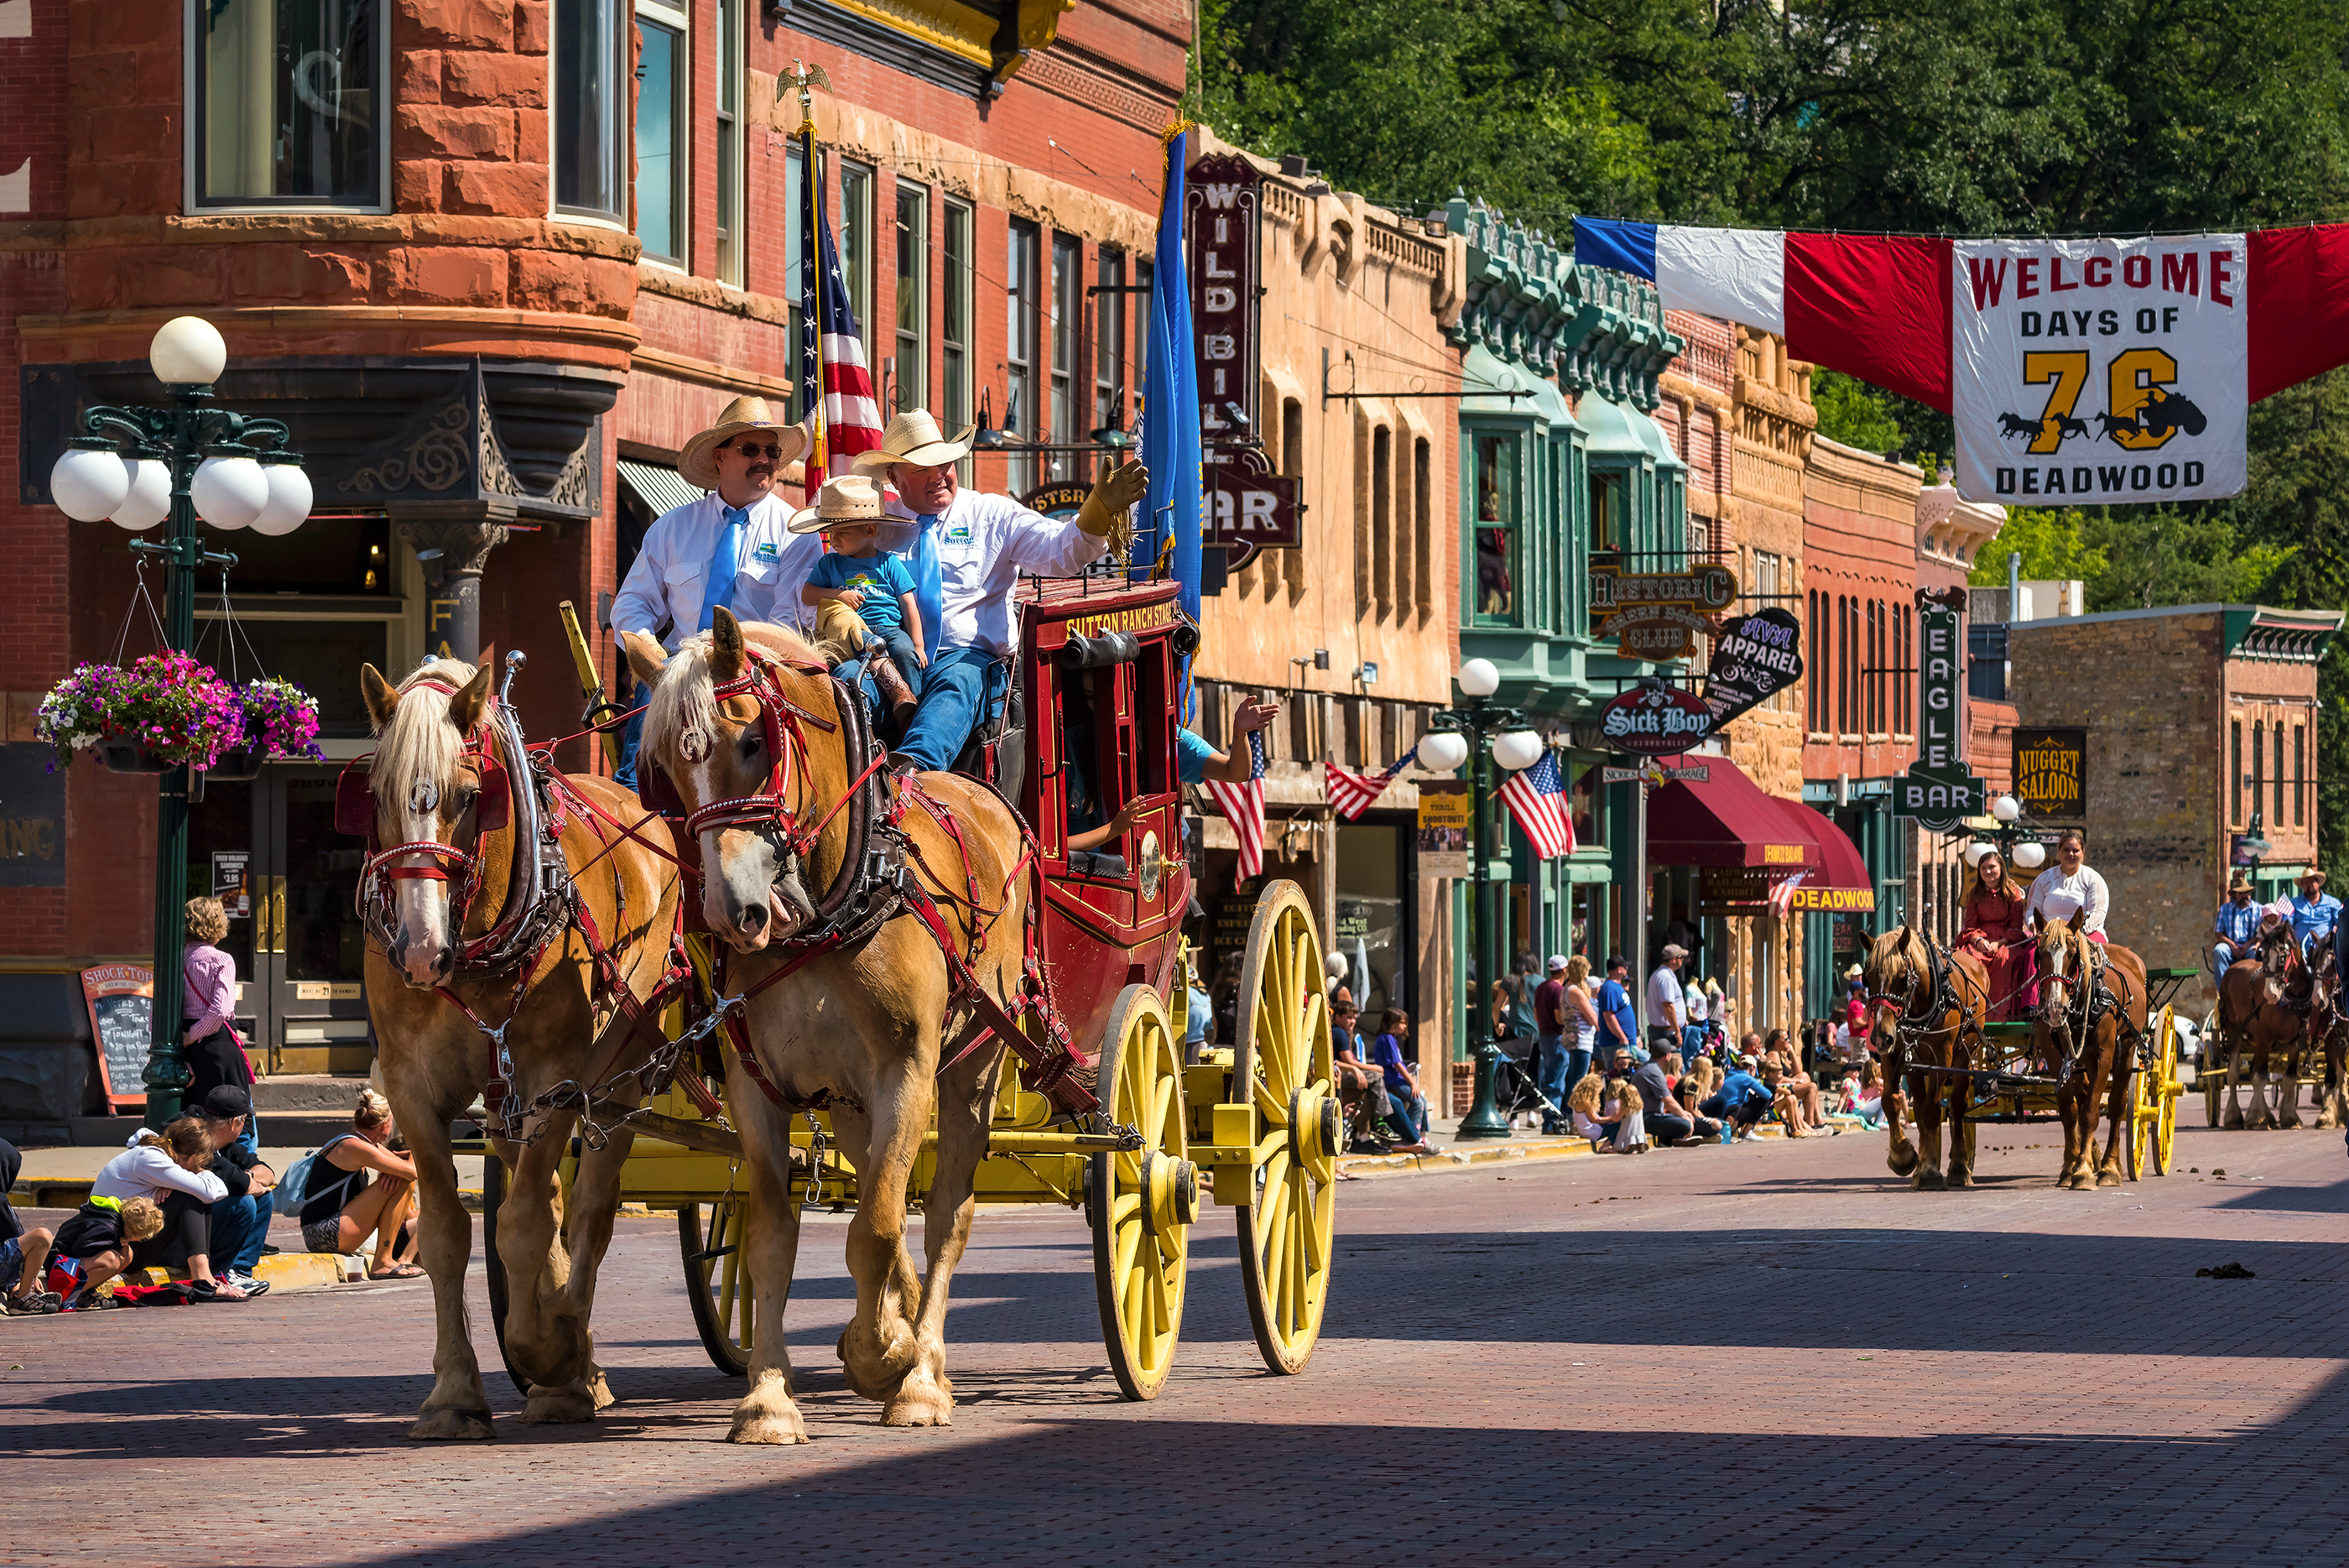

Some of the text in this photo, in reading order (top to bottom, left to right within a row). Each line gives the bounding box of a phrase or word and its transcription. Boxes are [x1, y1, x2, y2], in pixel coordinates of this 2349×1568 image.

[1204, 183, 1242, 313] WILD
[1968, 250, 2233, 312] WELCOME
[2021, 306, 2179, 336] DAYS OF
[1203, 334, 1237, 464] BILL
[2023, 346, 2178, 455] 76
[1995, 461, 2205, 495] DEADWOOD
[1203, 489, 1282, 531] AR
[1589, 570, 1728, 608] HISTORIC
[1065, 612, 1119, 641] SUTTON
[1122, 606, 1153, 632] RANCH
[1606, 605, 1707, 634] GREEN DOOR
[1740, 617, 1794, 650] AVA
[1629, 627, 1684, 649] CLUB
[1720, 633, 1797, 675] APPAREL
[1927, 628, 1950, 768] EAGLE
[1603, 706, 1711, 737] Sick Boy
[1626, 739, 1688, 748] MOTORCYCLES
[2018, 749, 2080, 780] NUGGET
[1906, 784, 1971, 810] BAR
[2018, 770, 2079, 800] SALOON
[1706, 878, 1762, 887] RAILROAD
[1712, 888, 1756, 896] EXHIBIT
[1793, 889, 1874, 909] DEADWOOD
[1833, 913, 1846, 923] THE
[85, 966, 153, 986] SHOCK TOP
[323, 987, 330, 996] 21
